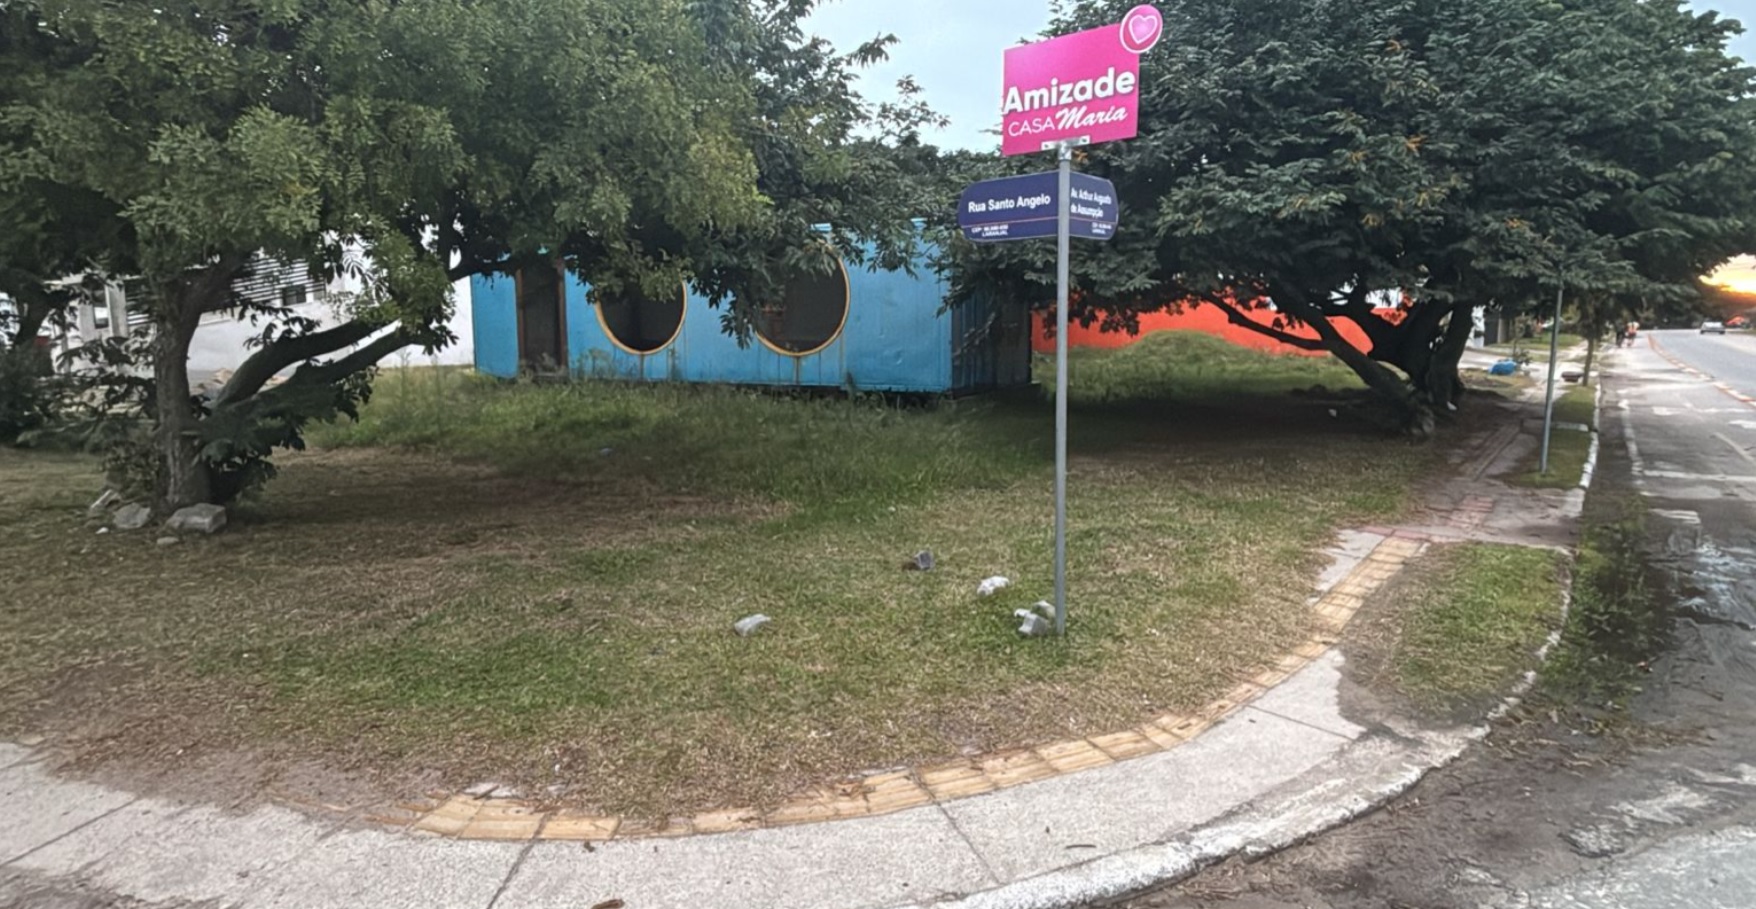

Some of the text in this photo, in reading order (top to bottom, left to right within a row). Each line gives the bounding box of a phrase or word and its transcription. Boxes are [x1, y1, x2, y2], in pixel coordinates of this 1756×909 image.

[1002, 67, 1135, 115] Amizade
[1008, 105, 1127, 137] CASA Maria
[968, 193, 1051, 213] Rua Santo Angelo
